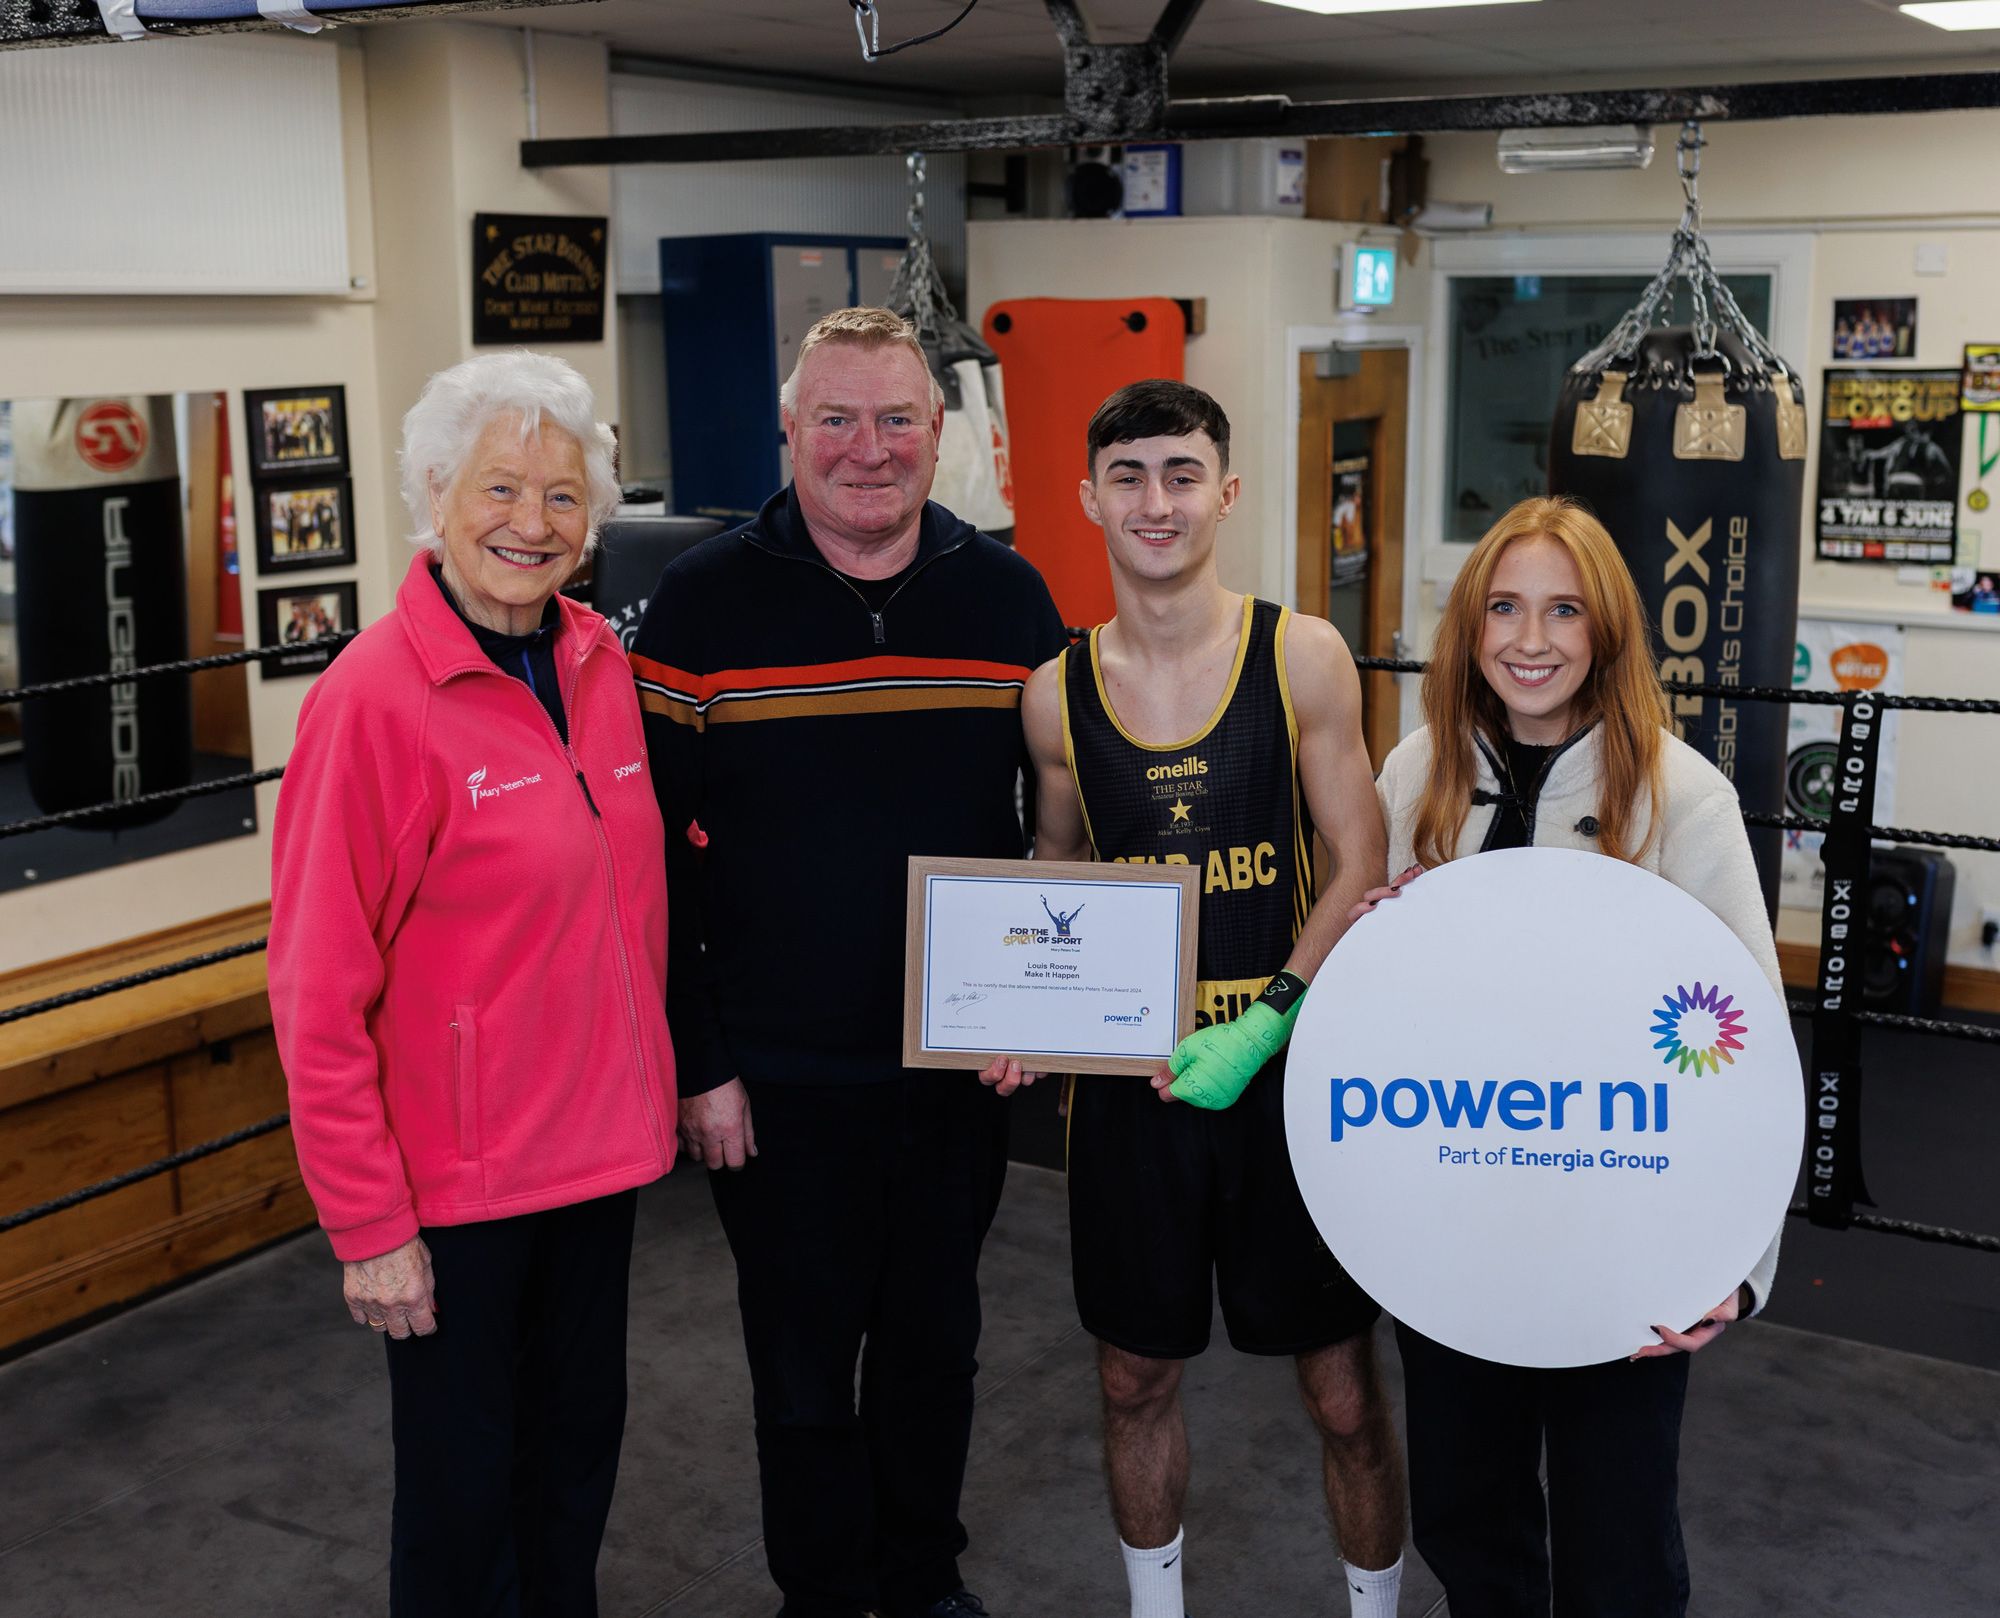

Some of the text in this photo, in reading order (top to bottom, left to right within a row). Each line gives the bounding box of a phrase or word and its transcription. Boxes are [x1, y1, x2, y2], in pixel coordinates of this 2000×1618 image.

[512, 233, 555, 260] STAR
[1720, 516, 1748, 632] Choice
[613, 761, 642, 781] power
[479, 772, 543, 799] Mary Peters Trust
[1153, 780, 1203, 794] THE STAR
[1195, 788, 1209, 796] Club
[1204, 841, 1278, 894] ABC
[1003, 934, 1083, 946] SPIRIT OF SPORT
[1009, 927, 1049, 936] FOR THE
[1024, 970, 1044, 978] Make
[1052, 972, 1080, 980] Happen
[1027, 962, 1078, 972] Louis Rooney
[1104, 1015, 1133, 1023] power
[1330, 1076, 1669, 1143] power ni
[1439, 1145, 1670, 1174] Part of Energia Group
